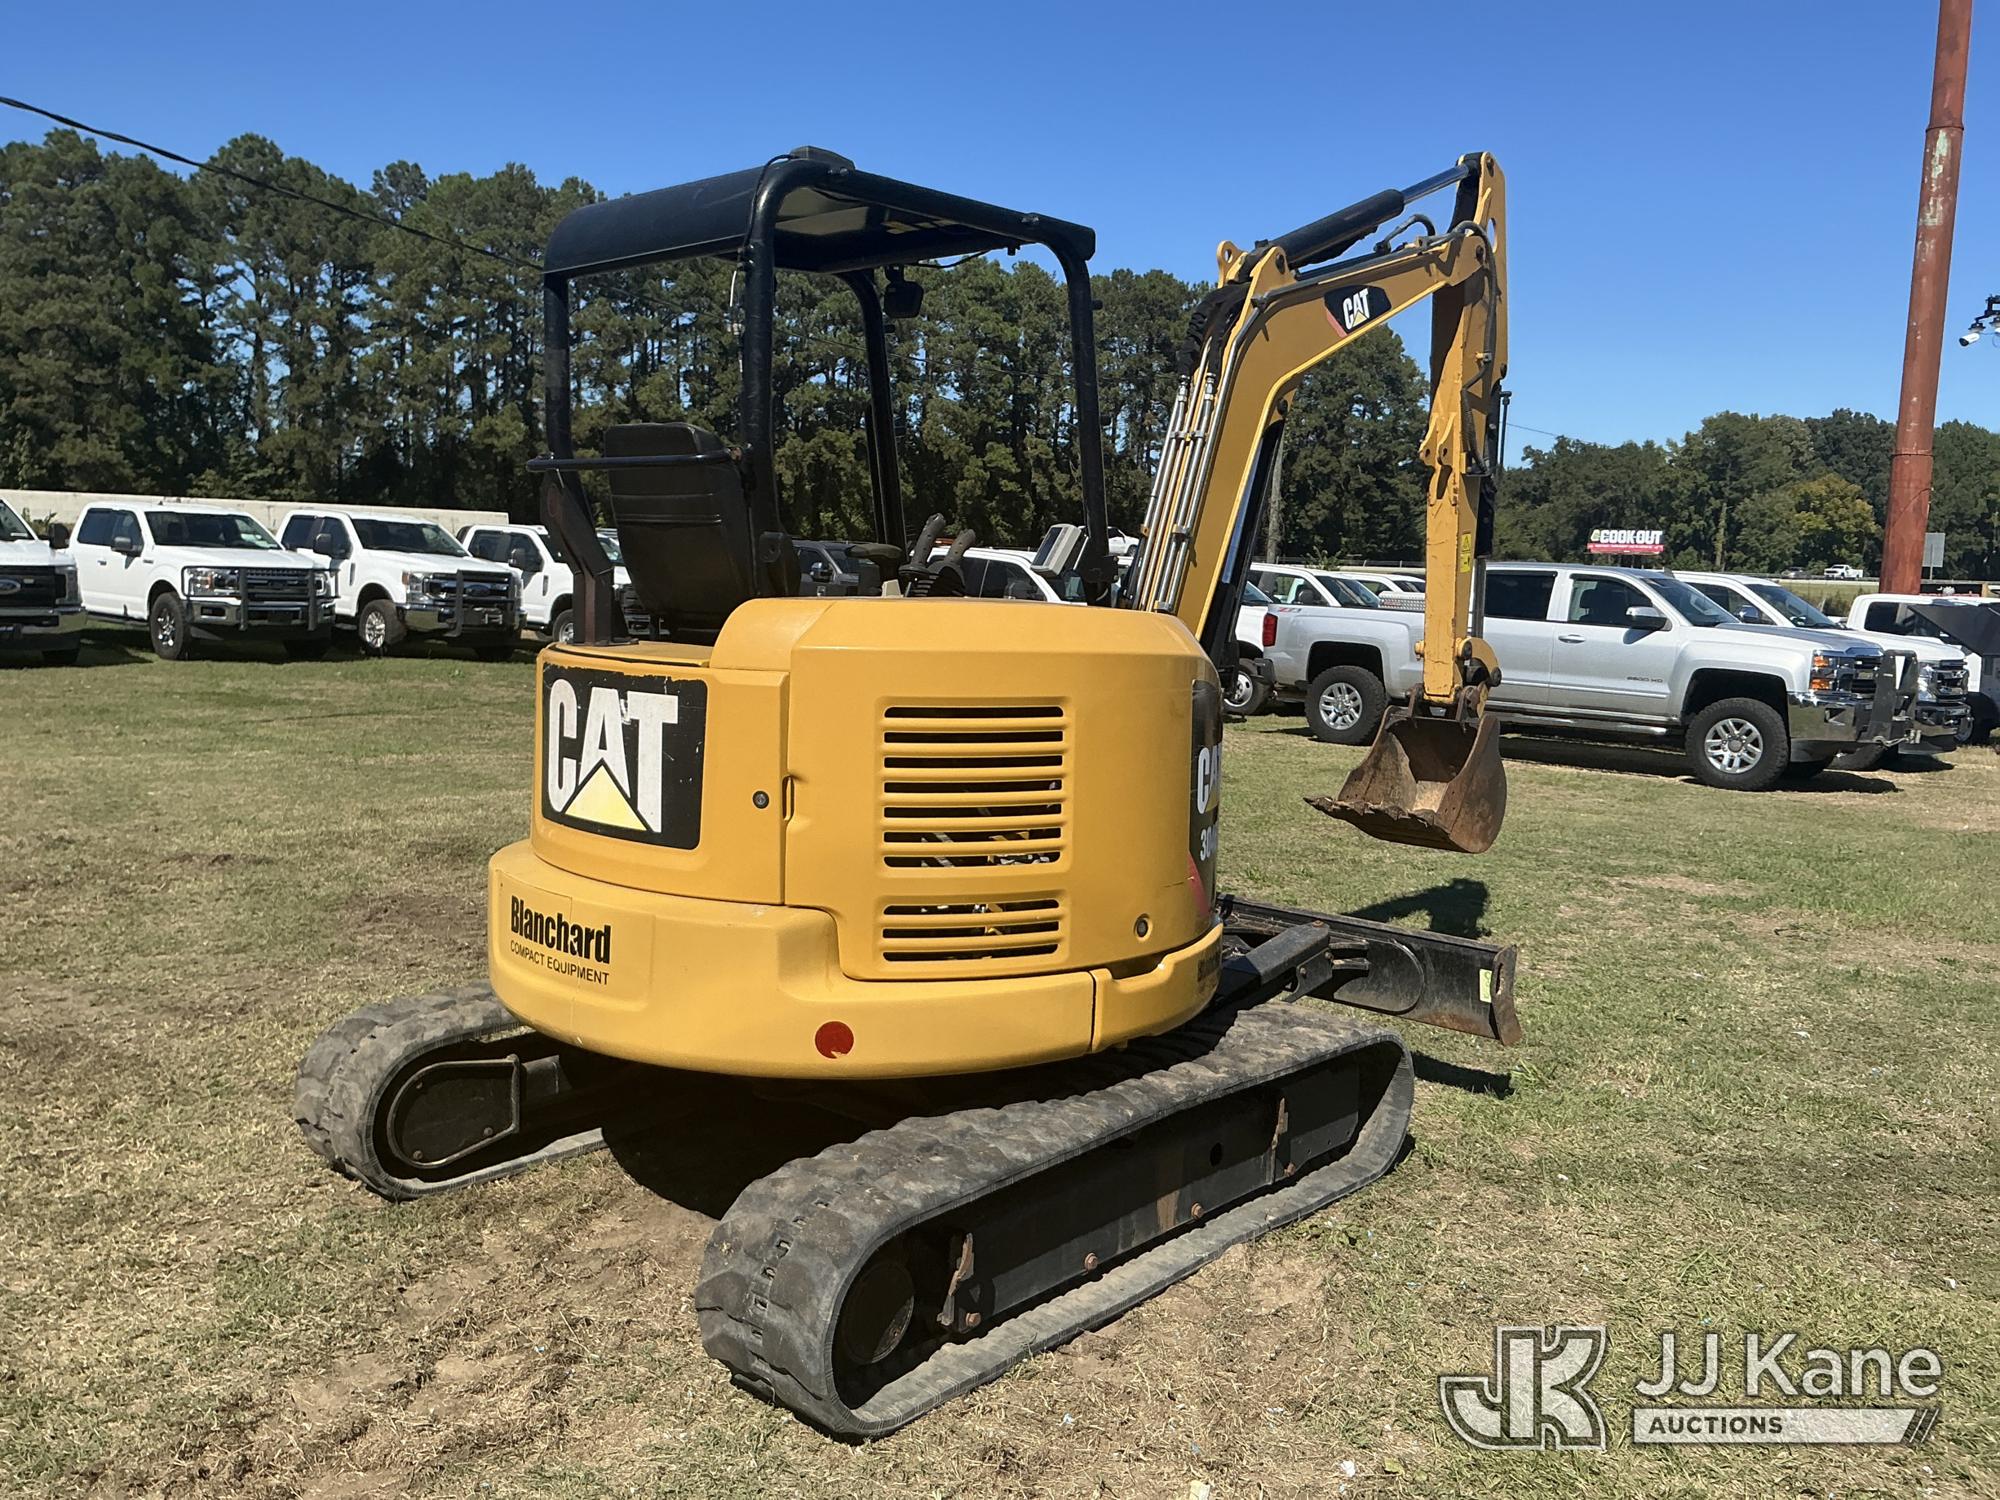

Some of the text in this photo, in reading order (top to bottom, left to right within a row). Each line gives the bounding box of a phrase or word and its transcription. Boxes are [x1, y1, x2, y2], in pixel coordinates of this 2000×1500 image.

[1342, 287, 1370, 330] CAT
[548, 678, 679, 834] CAT
[511, 894, 612, 965] Blanchard
[510, 939, 610, 986] COMPACT EQUIPMENT
